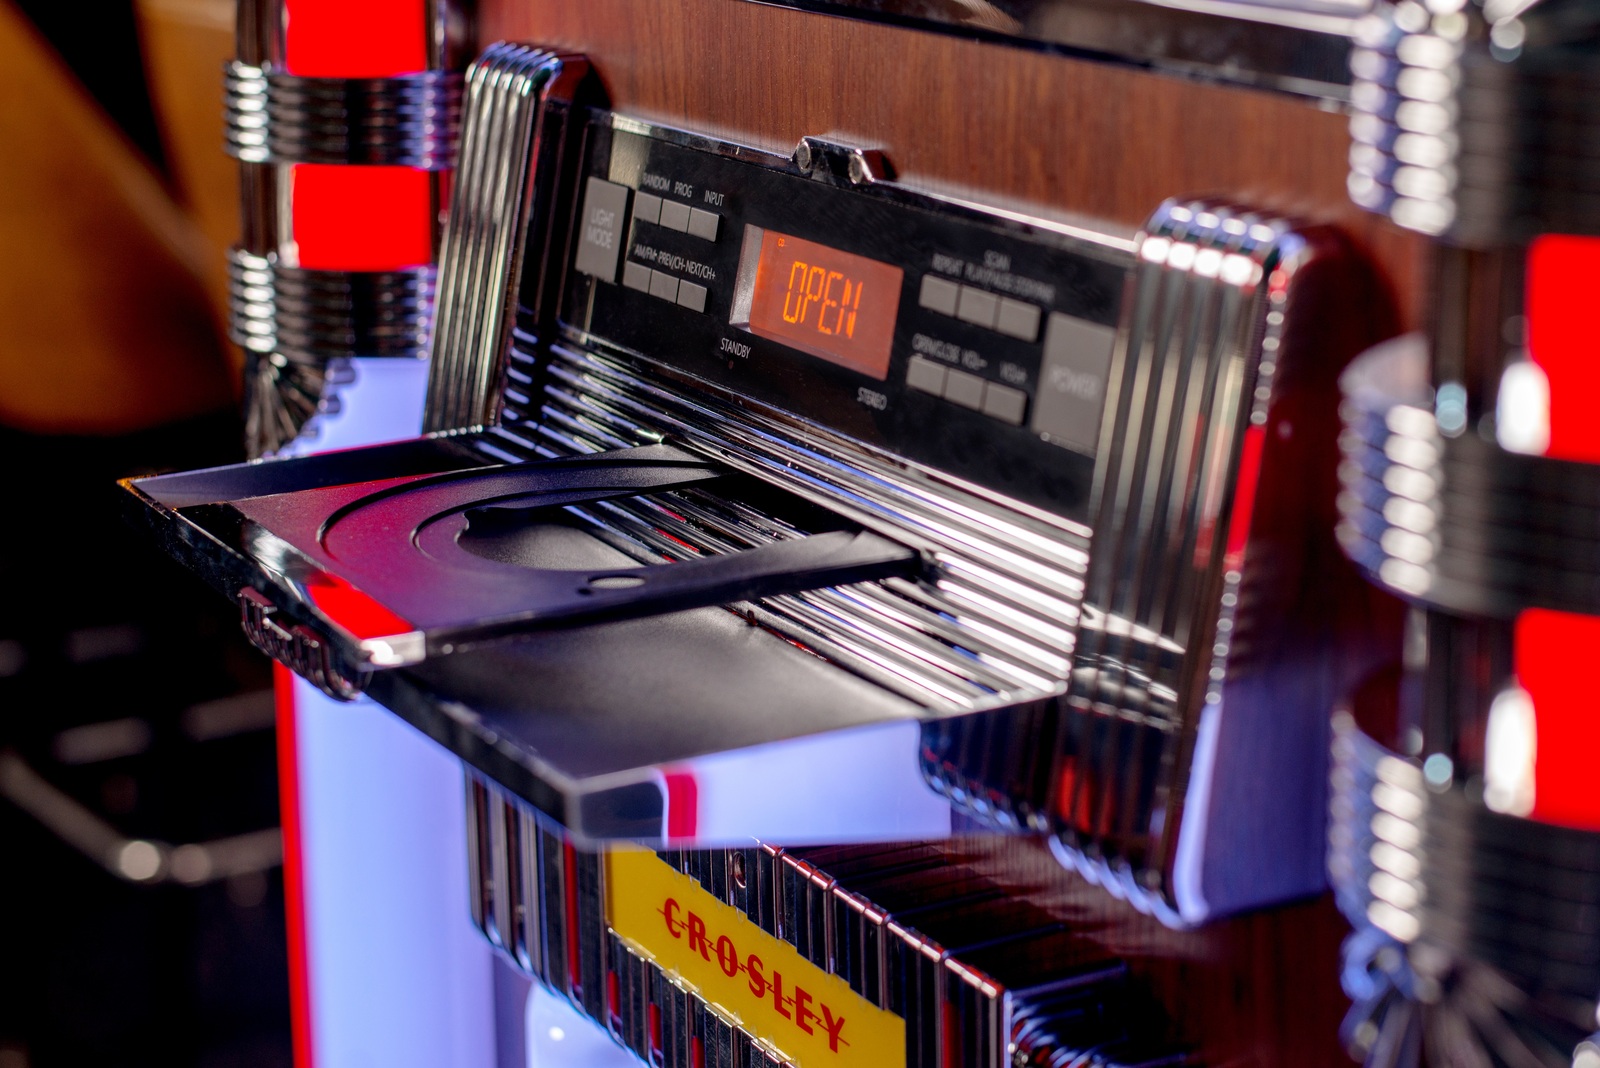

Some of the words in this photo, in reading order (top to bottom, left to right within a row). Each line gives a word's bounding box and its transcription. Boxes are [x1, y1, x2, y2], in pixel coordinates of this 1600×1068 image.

[674, 181, 693, 198] PROG
[704, 190, 725, 206] INPUT
[587, 226, 612, 248] MODE
[783, 261, 863, 339] OPEN
[720, 337, 751, 359] STANDBY
[657, 898, 850, 1053] CROSLEY
